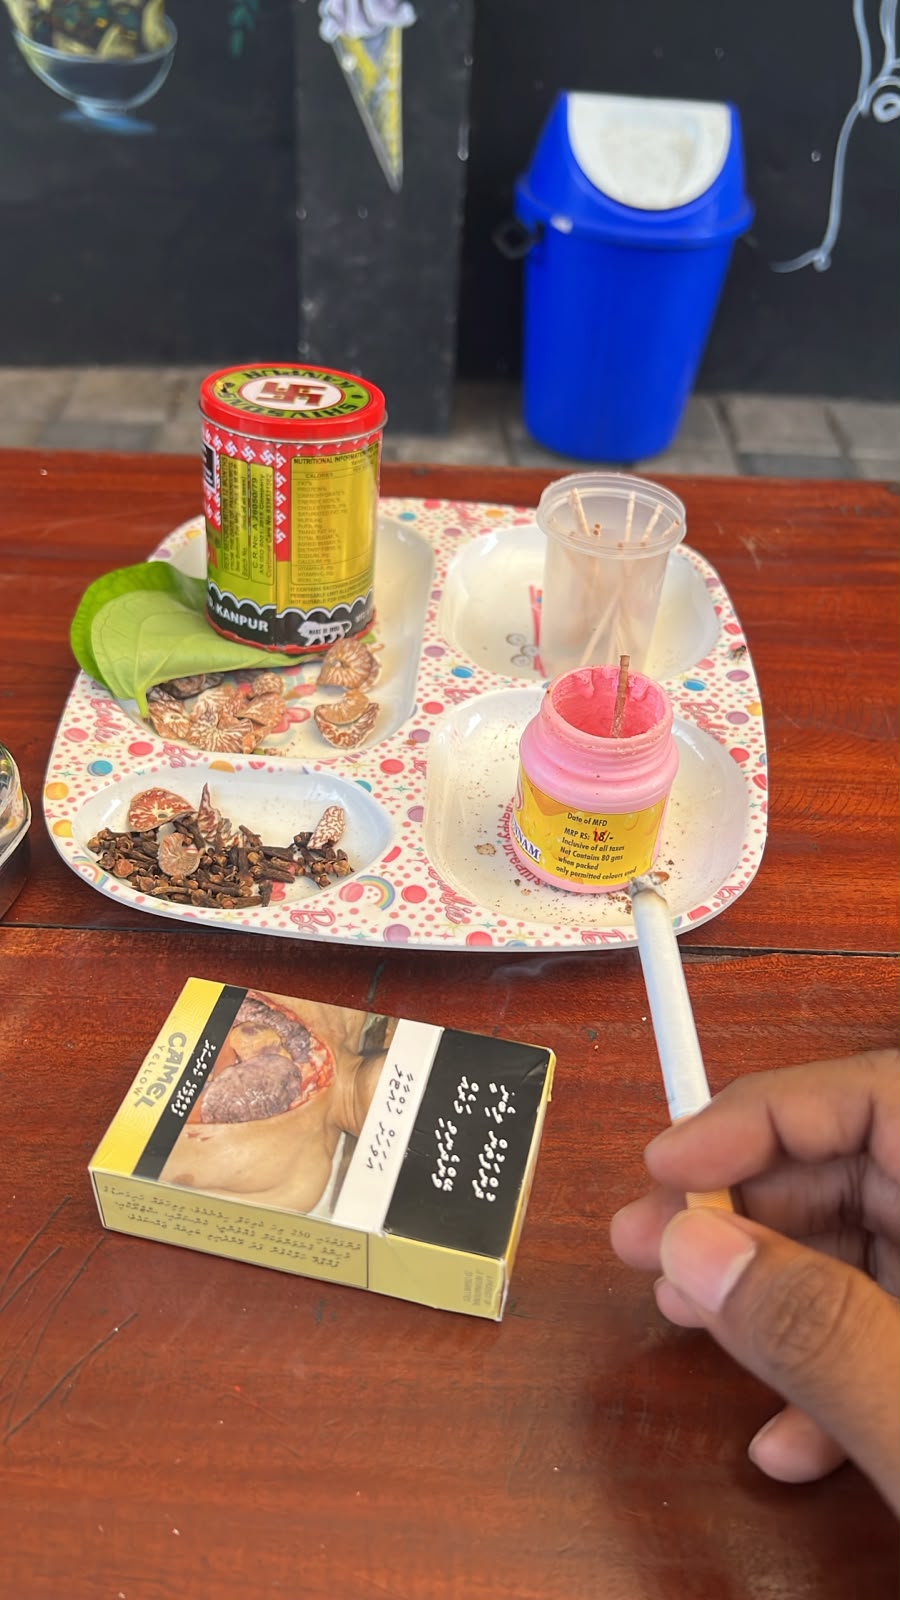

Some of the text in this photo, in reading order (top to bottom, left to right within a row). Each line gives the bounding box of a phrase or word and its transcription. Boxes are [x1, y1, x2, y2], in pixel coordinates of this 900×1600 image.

[215, 604, 269, 632] KANPUR
[567, 813, 583, 823] Date
[592, 819, 608, 827] MFD
[564, 827, 578, 838] MRP
[580, 832, 590, 840] RS:
[562, 837, 589, 851] Inclusive
[590, 844, 597, 852] of
[599, 844, 608, 852] all
[572, 850, 600, 861] Contains
[558, 856, 599, 871] when packed
[556, 865, 569, 876] only
[570, 870, 601, 880] permitted
[624, 866, 637, 877] used
[133, 1031, 187, 1109] CAMEL
[133, 1045, 166, 1097] YELLOW
